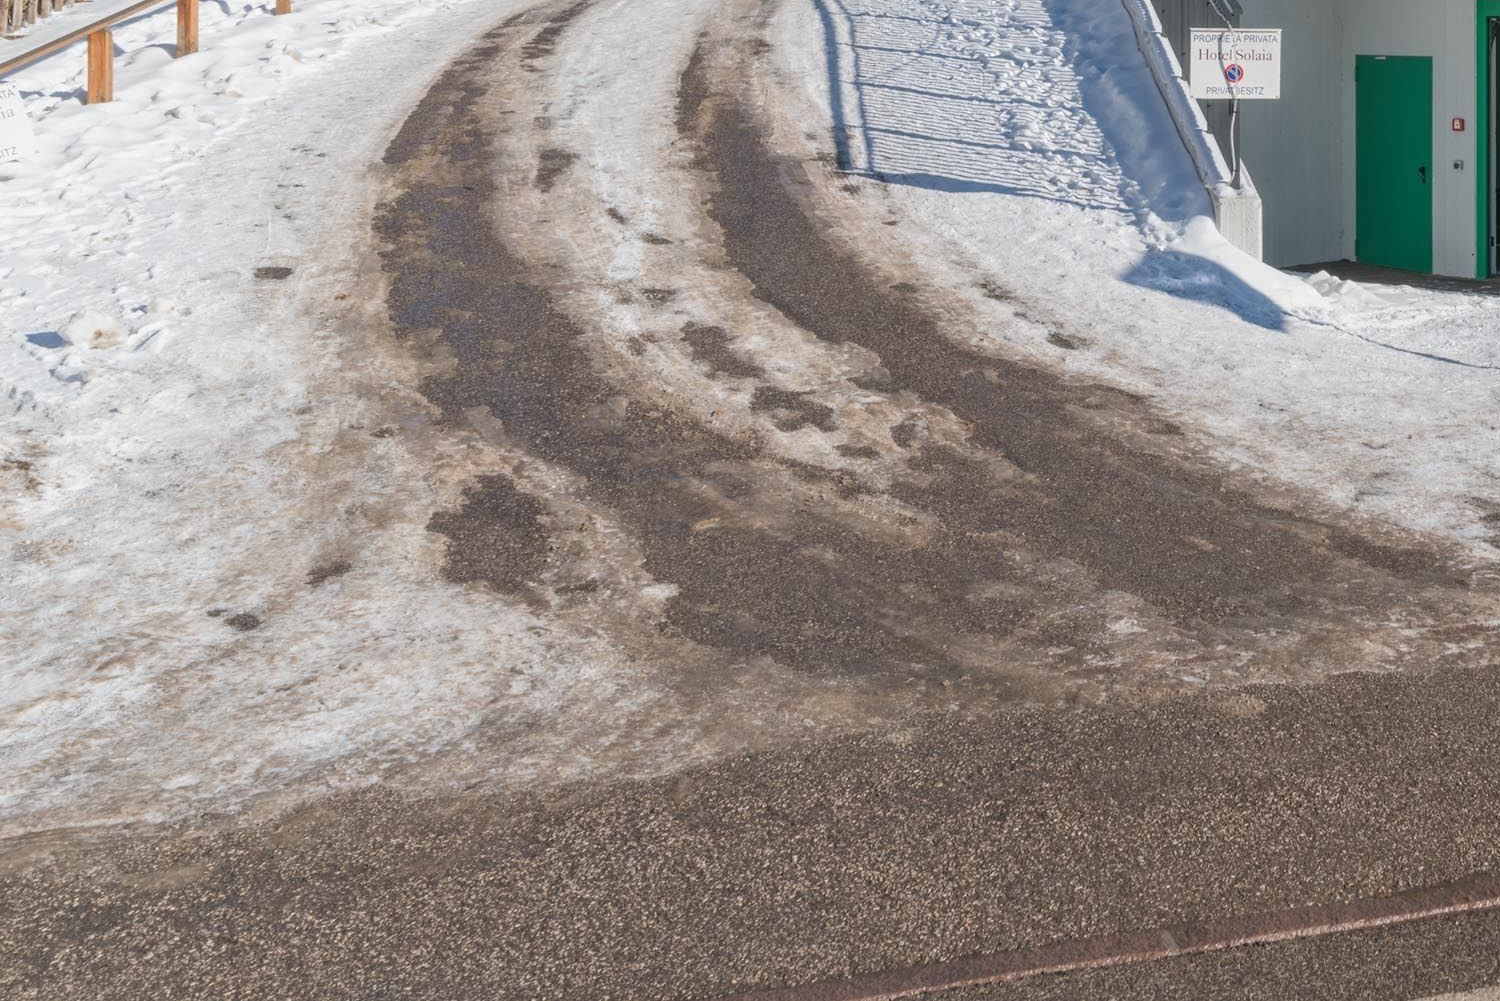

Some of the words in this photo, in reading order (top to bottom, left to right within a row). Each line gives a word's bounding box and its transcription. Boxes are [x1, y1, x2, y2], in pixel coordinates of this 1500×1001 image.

[1243, 34, 1279, 44] PRIVATA
[1199, 48, 1233, 61] Hotel
[1235, 48, 1273, 61] Solaia
